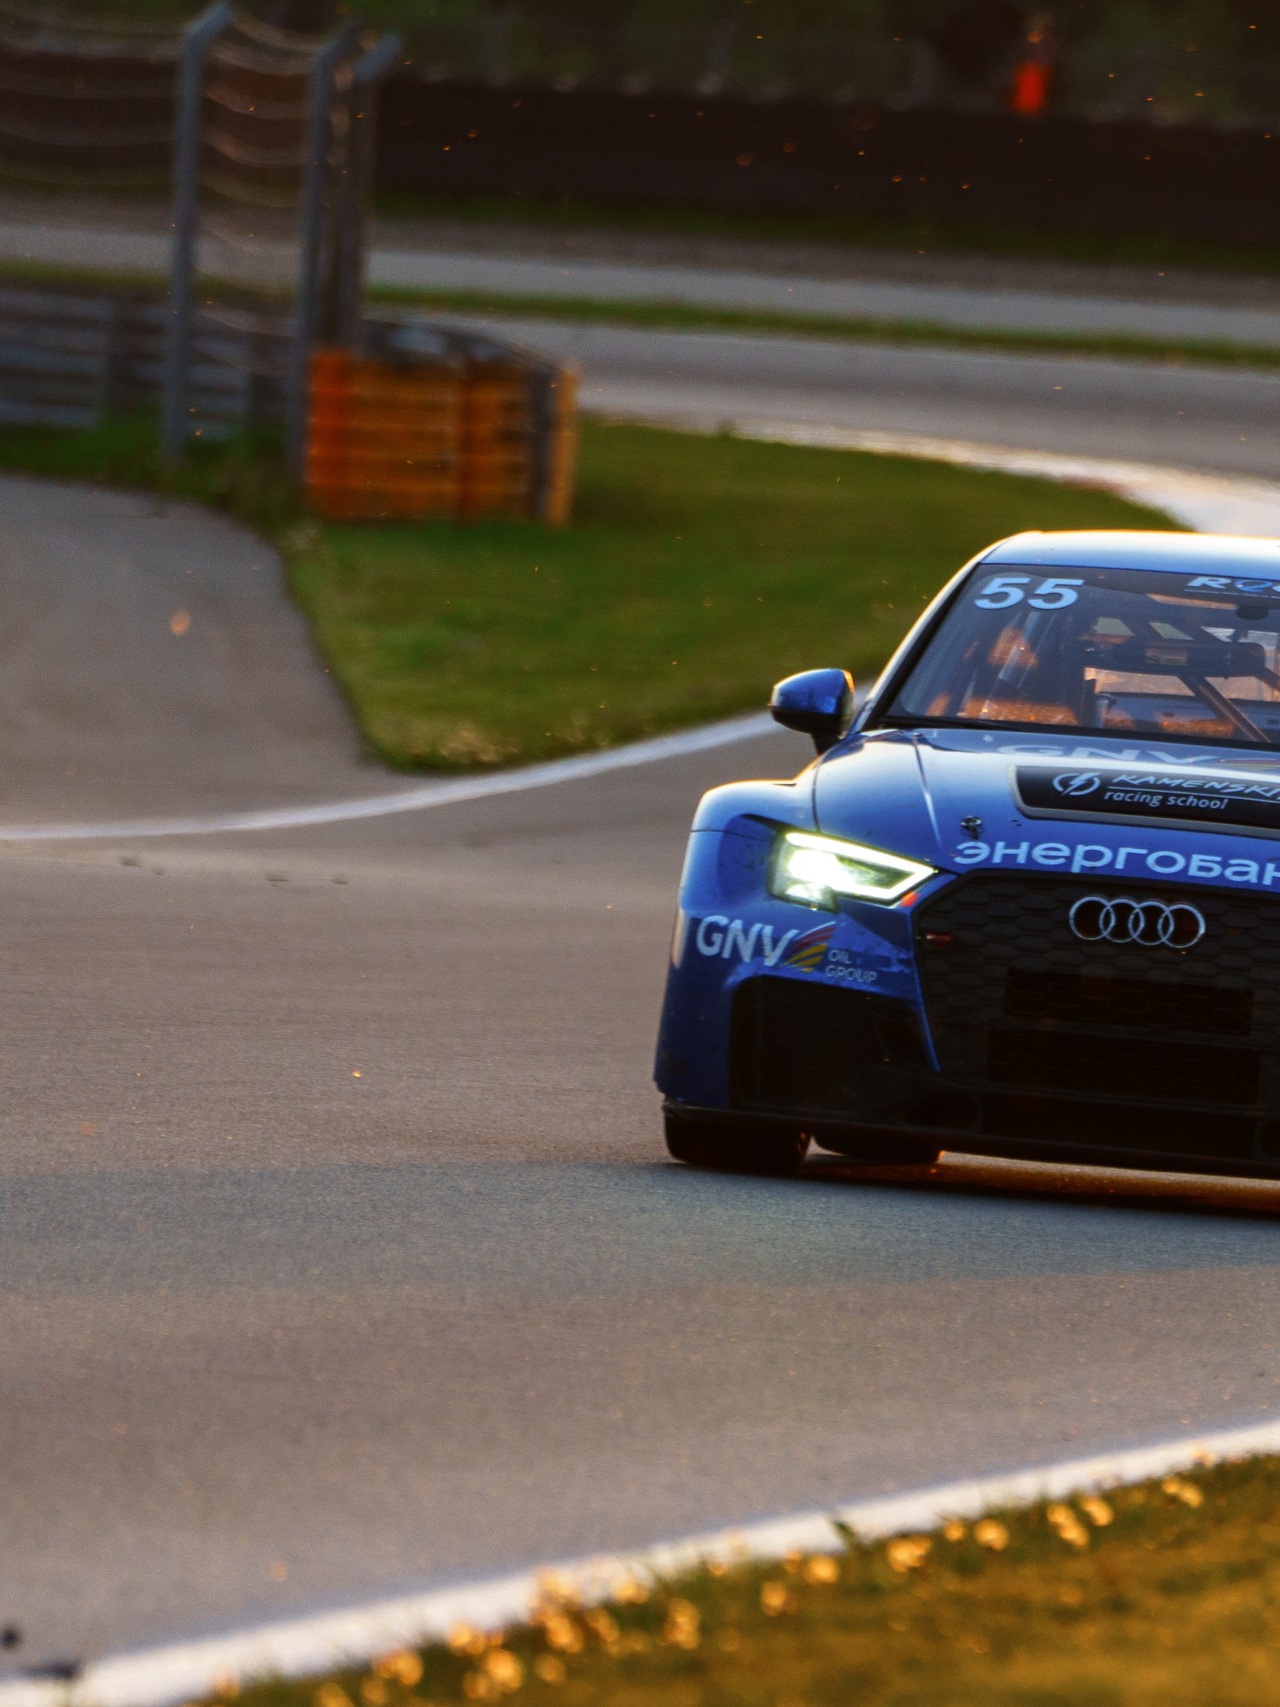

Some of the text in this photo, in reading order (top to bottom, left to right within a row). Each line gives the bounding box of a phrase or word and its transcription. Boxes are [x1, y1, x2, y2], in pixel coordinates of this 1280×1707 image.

[973, 576, 1085, 611] 55
[996, 745, 1220, 764] GNV
[1103, 790, 1229, 810] racing school
[696, 915, 799, 967] GNV
[828, 949, 851, 964] OIL
[825, 966, 877, 984] GROUP
